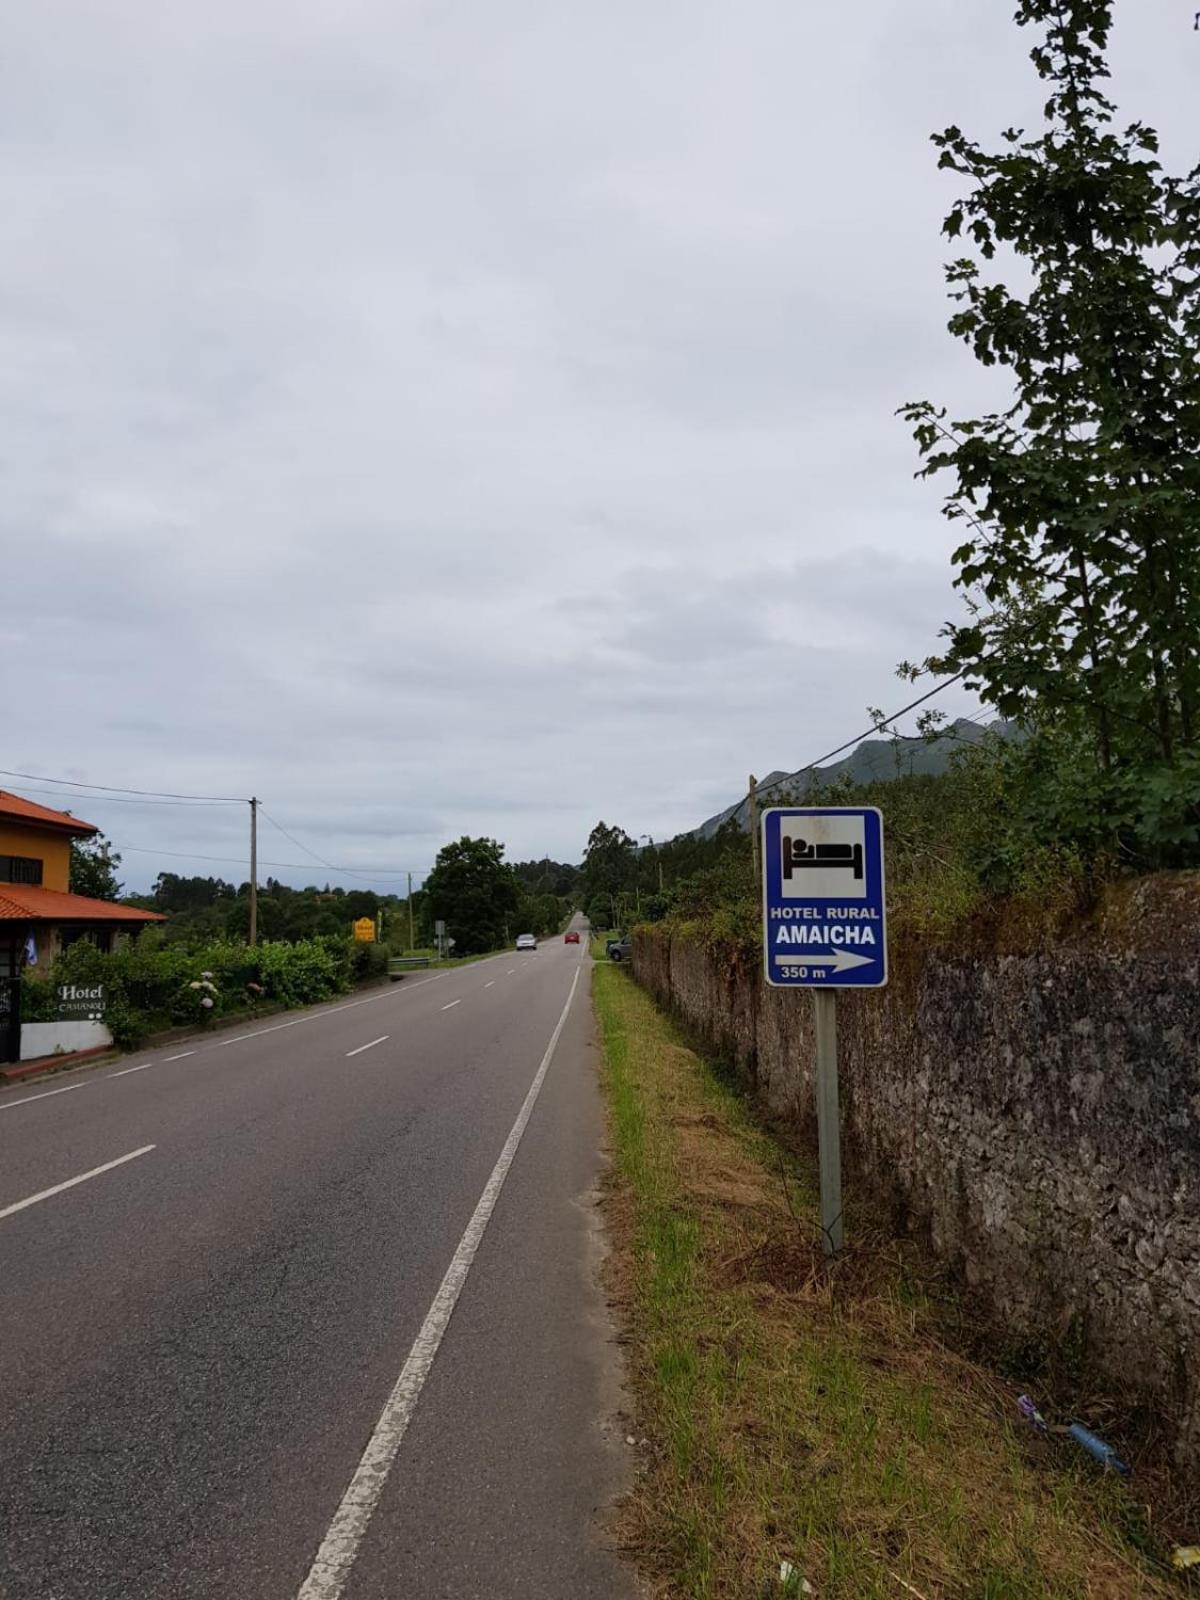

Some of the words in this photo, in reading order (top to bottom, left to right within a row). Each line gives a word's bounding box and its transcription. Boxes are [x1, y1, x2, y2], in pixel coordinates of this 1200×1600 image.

[770, 907, 822, 919] HOTEL
[826, 907, 880, 919] RURAL
[776, 925, 876, 944] AMAICHA
[781, 966, 808, 978] 350
[812, 969, 826, 978] m
[58, 984, 103, 1000] Hotel
